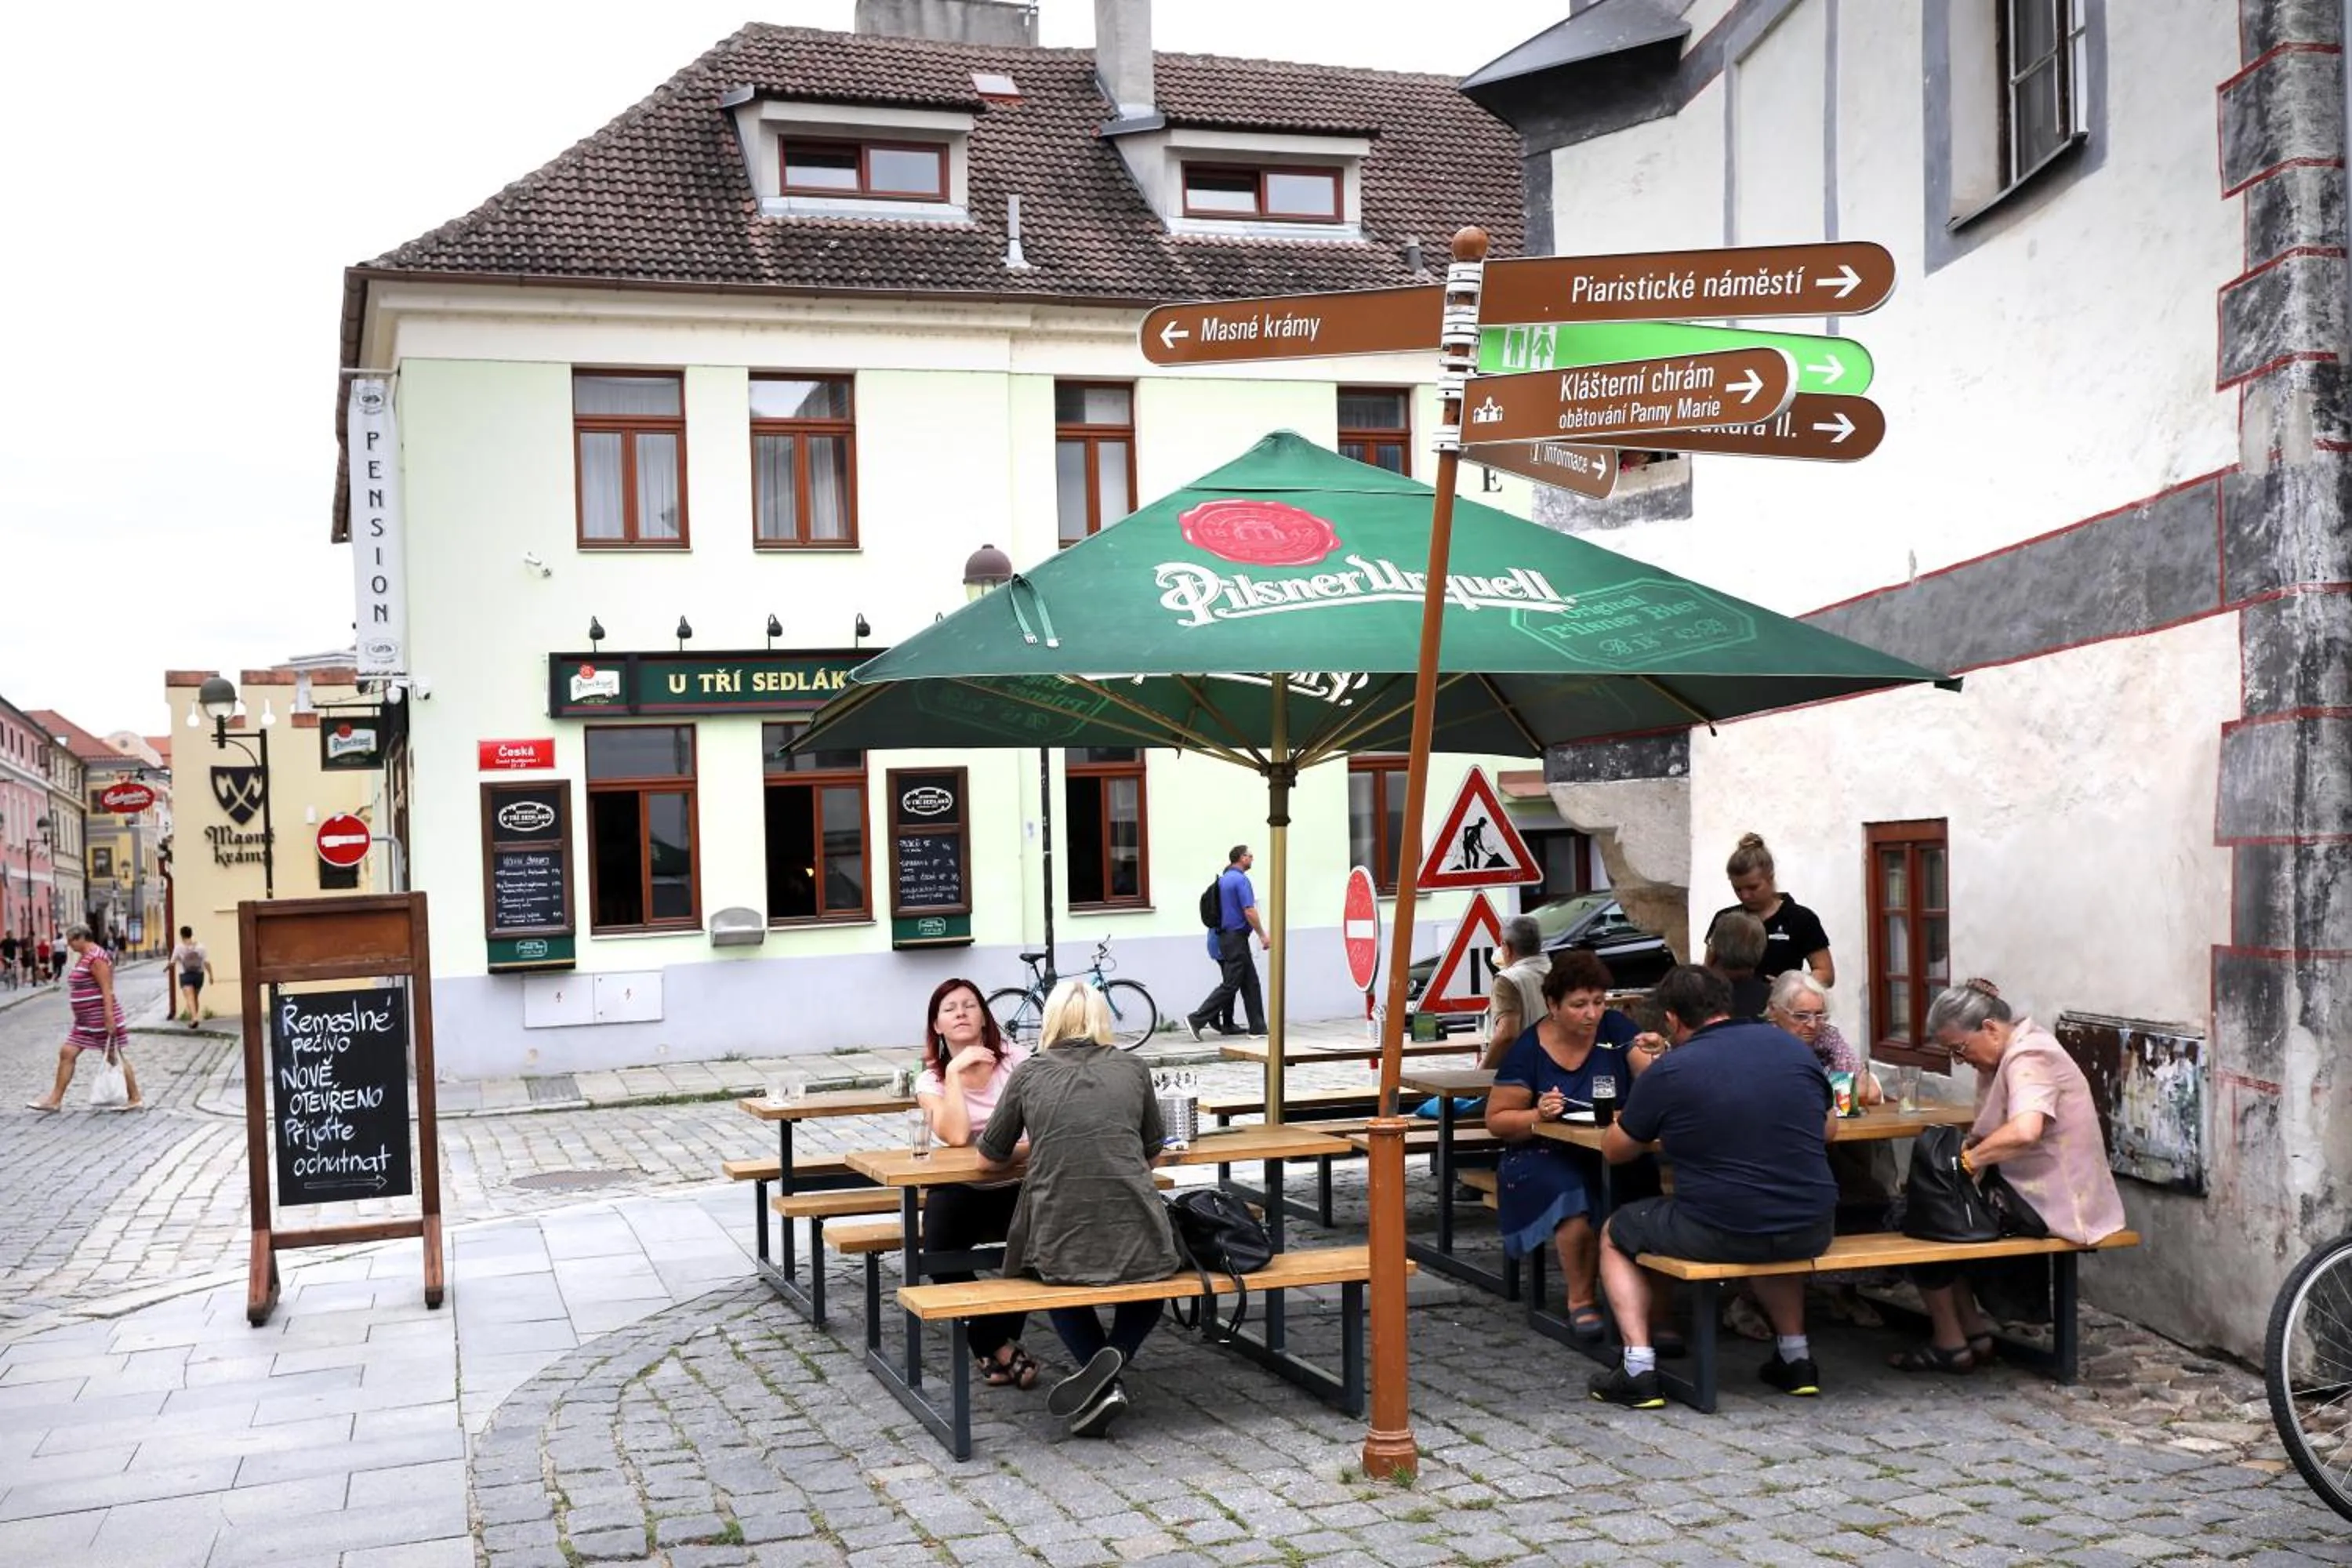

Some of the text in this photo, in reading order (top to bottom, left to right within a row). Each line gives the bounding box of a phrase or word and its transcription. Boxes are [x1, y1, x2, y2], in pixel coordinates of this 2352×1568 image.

[1572, 267, 1805, 303] Piaristické náměstí
[1201, 312, 1321, 343] Masné krámy
[1560, 361, 1715, 401] Klášterní chrám
[1559, 395, 1721, 430] obětování Panny Marie
[366, 431, 388, 622] PENSION
[1154, 561, 1365, 626] Pilsner
[1542, 600, 1701, 639] Pilsner Bier
[669, 673, 687, 694] U
[698, 669, 743, 693] TŘÍ
[498, 744, 535, 757] Česká
[282, 996, 394, 1036] Řemeslné
[291, 1033, 350, 1067] pečivo
[281, 1055, 334, 1091] NOVĚ
[289, 1081, 384, 1116] OTEVŘENO
[293, 1144, 393, 1177] ochutnat
